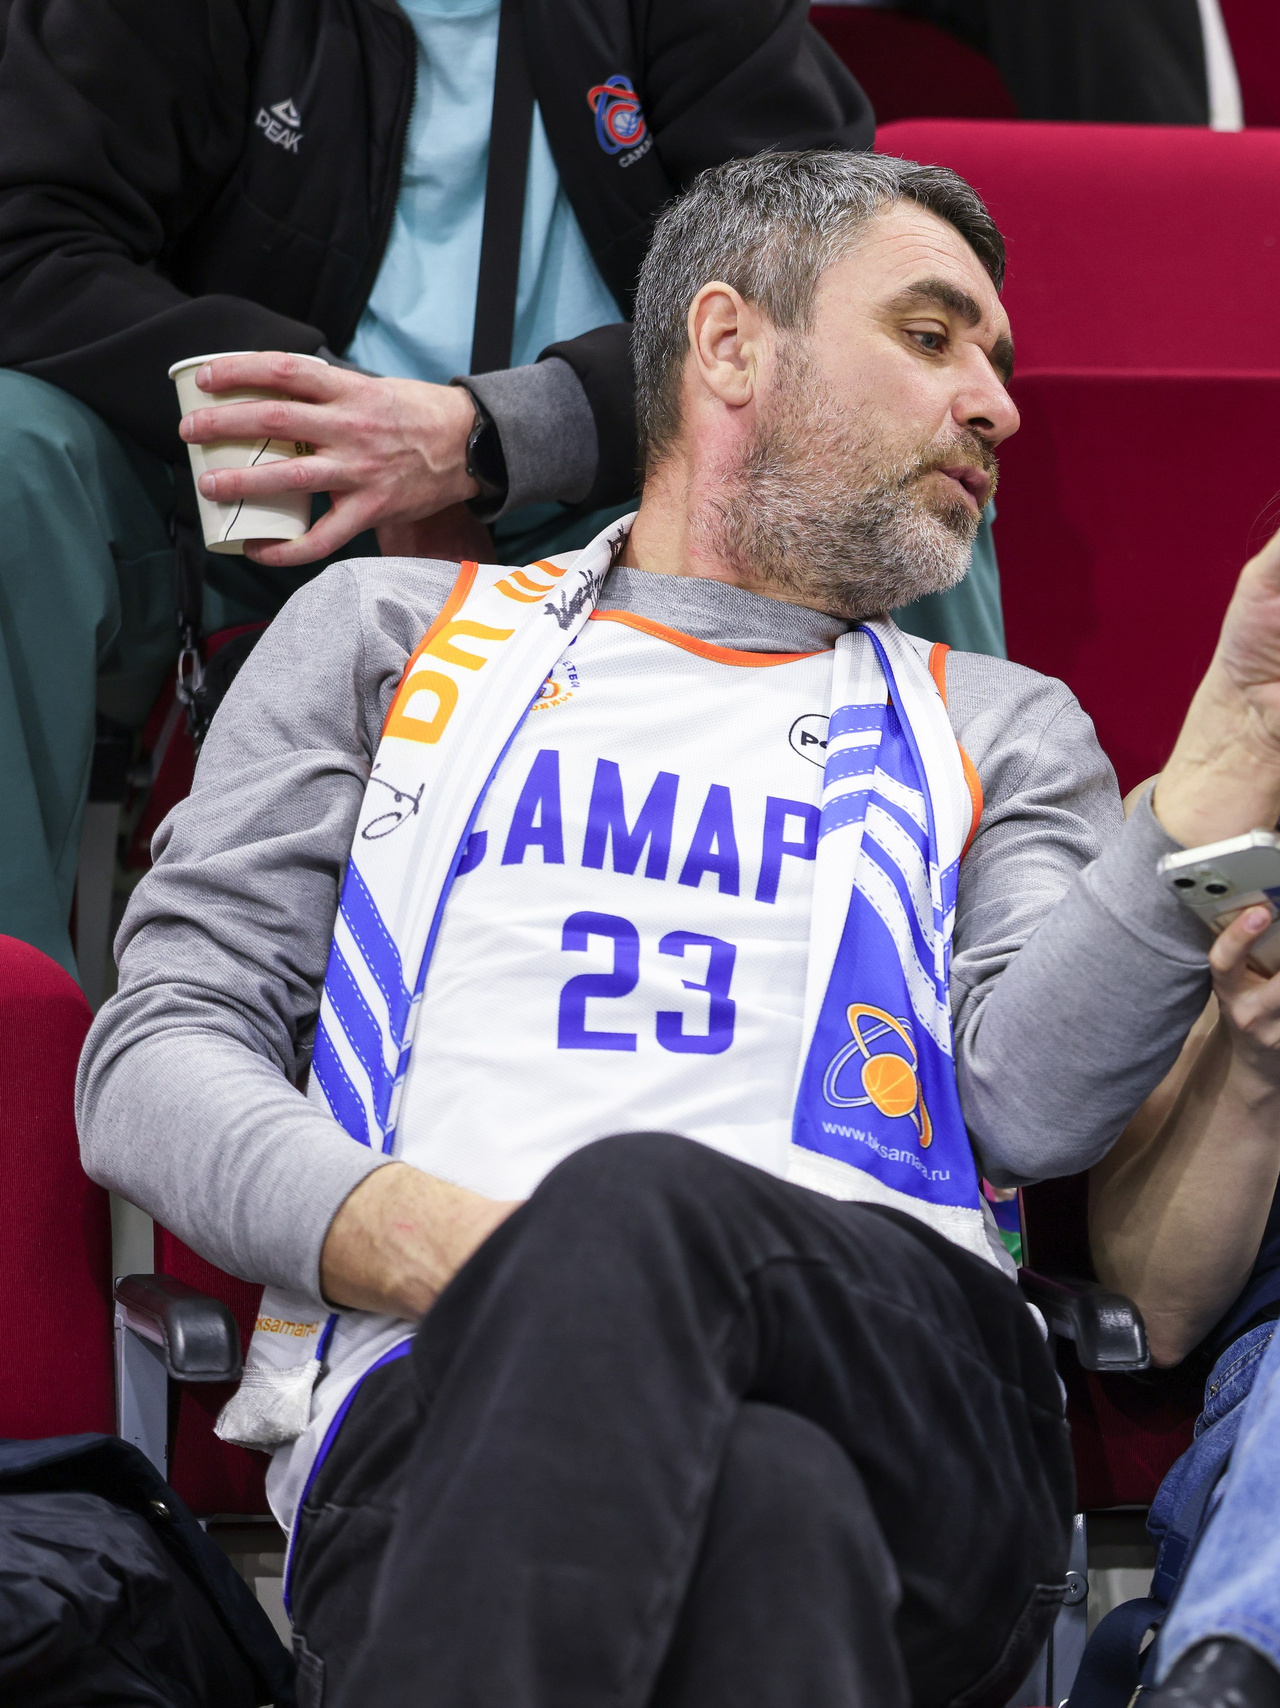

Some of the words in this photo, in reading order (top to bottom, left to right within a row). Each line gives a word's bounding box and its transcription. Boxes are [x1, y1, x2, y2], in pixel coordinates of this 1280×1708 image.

[254, 107, 304, 154] PEAK
[557, 911, 736, 1055] 23
[822, 1120, 950, 1181] www.bksama.ru
